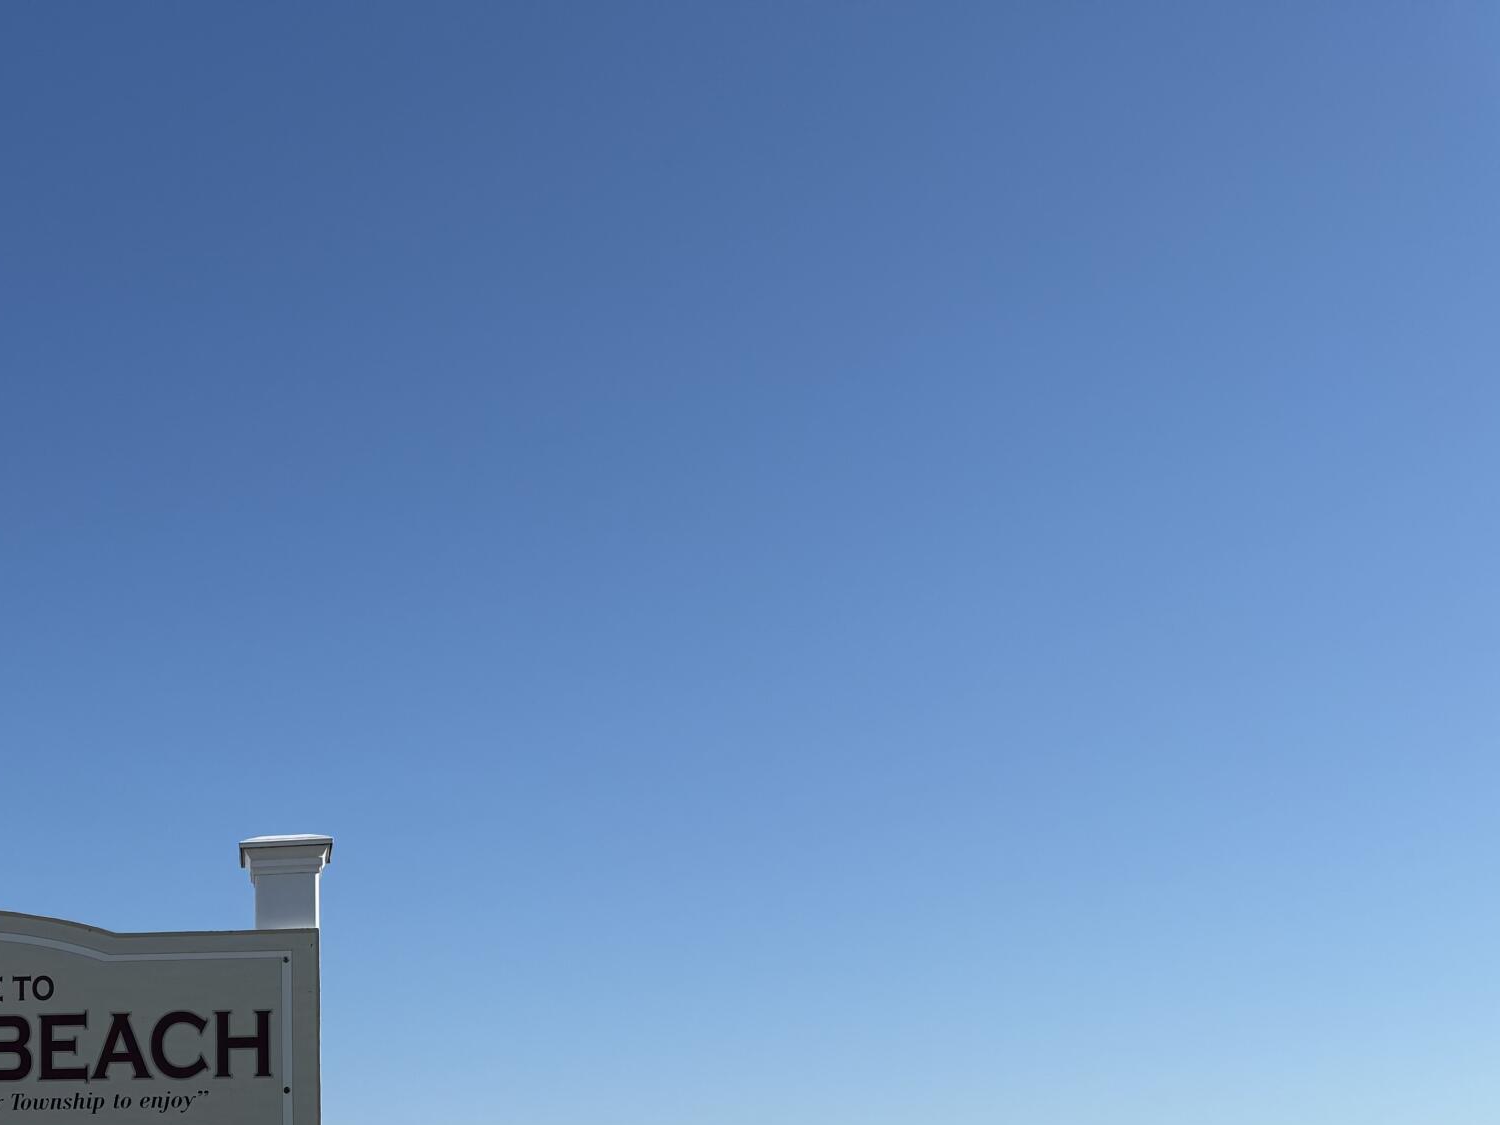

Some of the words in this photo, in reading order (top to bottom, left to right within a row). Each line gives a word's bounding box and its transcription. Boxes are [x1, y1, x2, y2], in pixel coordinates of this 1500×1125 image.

[11, 975, 55, 1002] TO
[11, 1092, 105, 1115] Township
[113, 1092, 133, 1110] to
